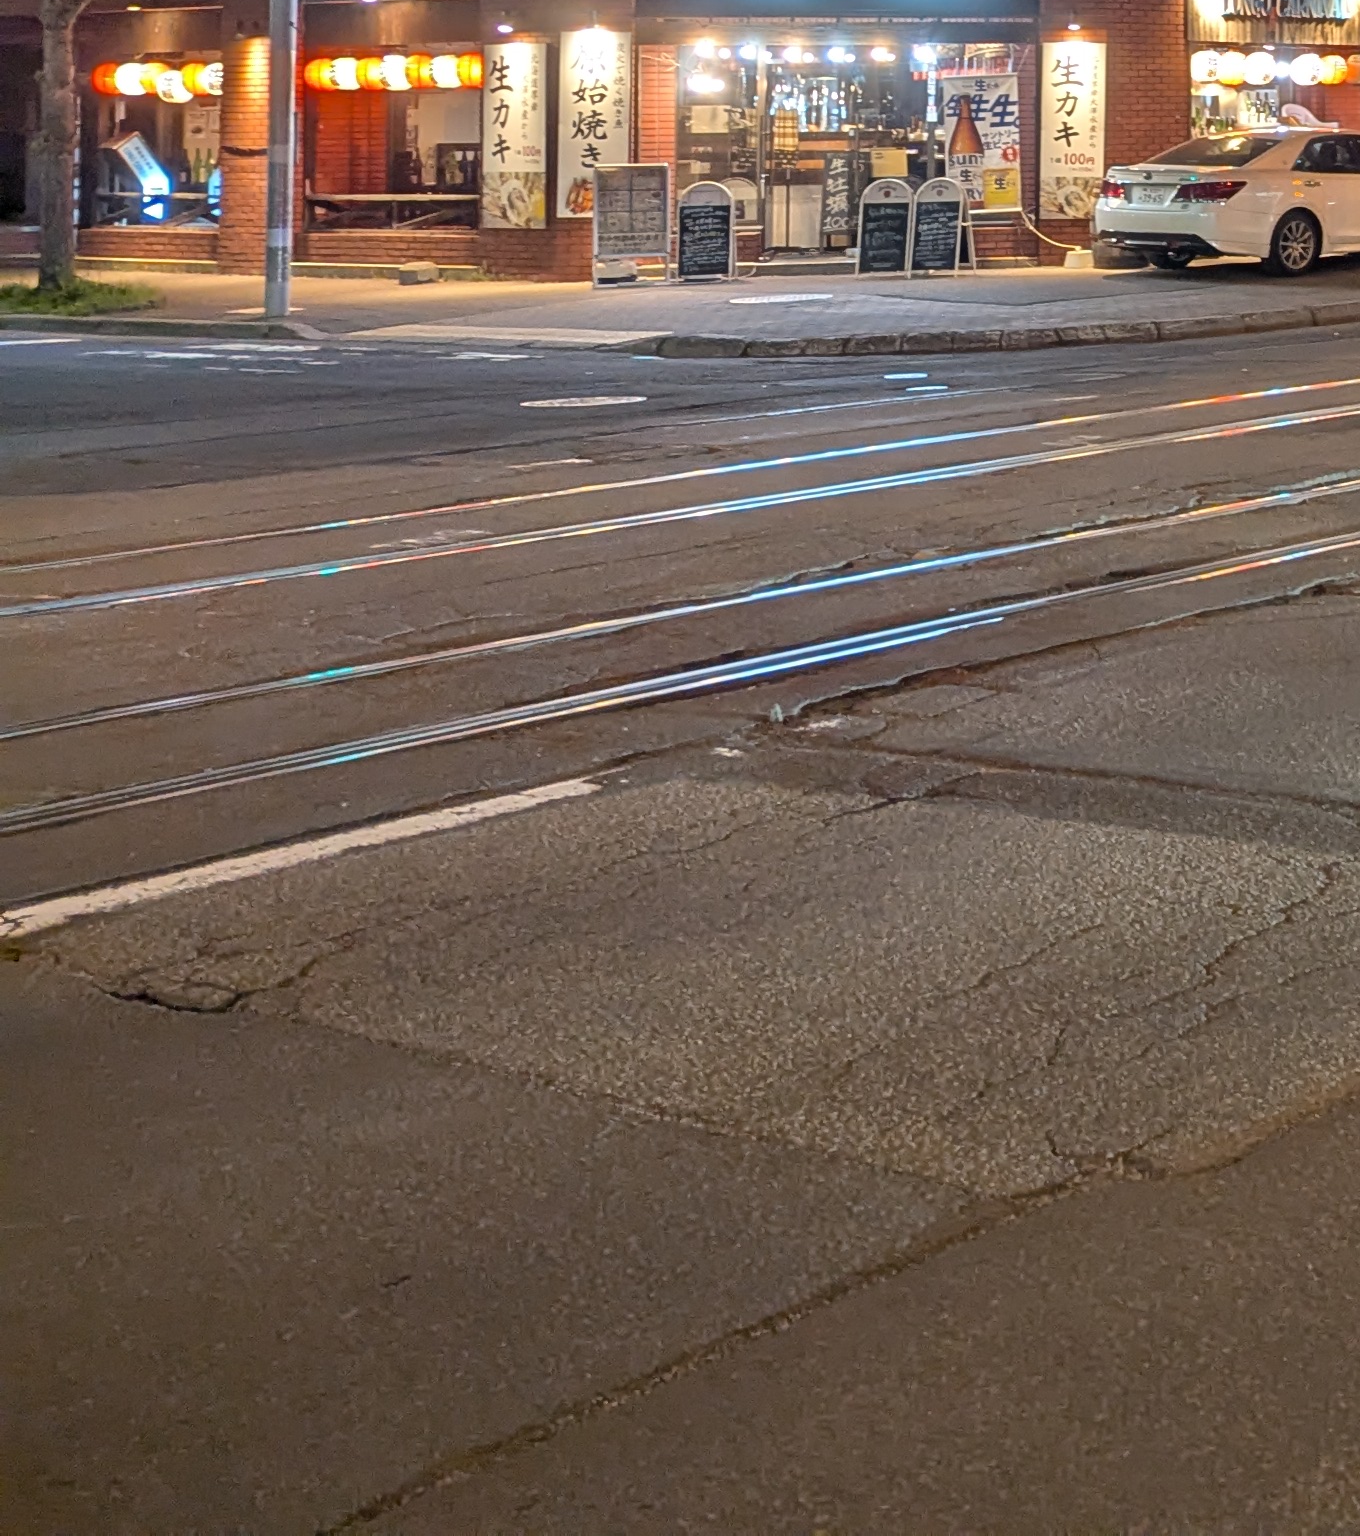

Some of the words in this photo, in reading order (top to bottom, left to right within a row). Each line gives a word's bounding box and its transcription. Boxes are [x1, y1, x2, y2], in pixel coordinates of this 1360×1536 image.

[489, 55, 514, 164] 生カキ
[1051, 56, 1084, 148] 生カキ
[1064, 153, 1095, 166] 100円
